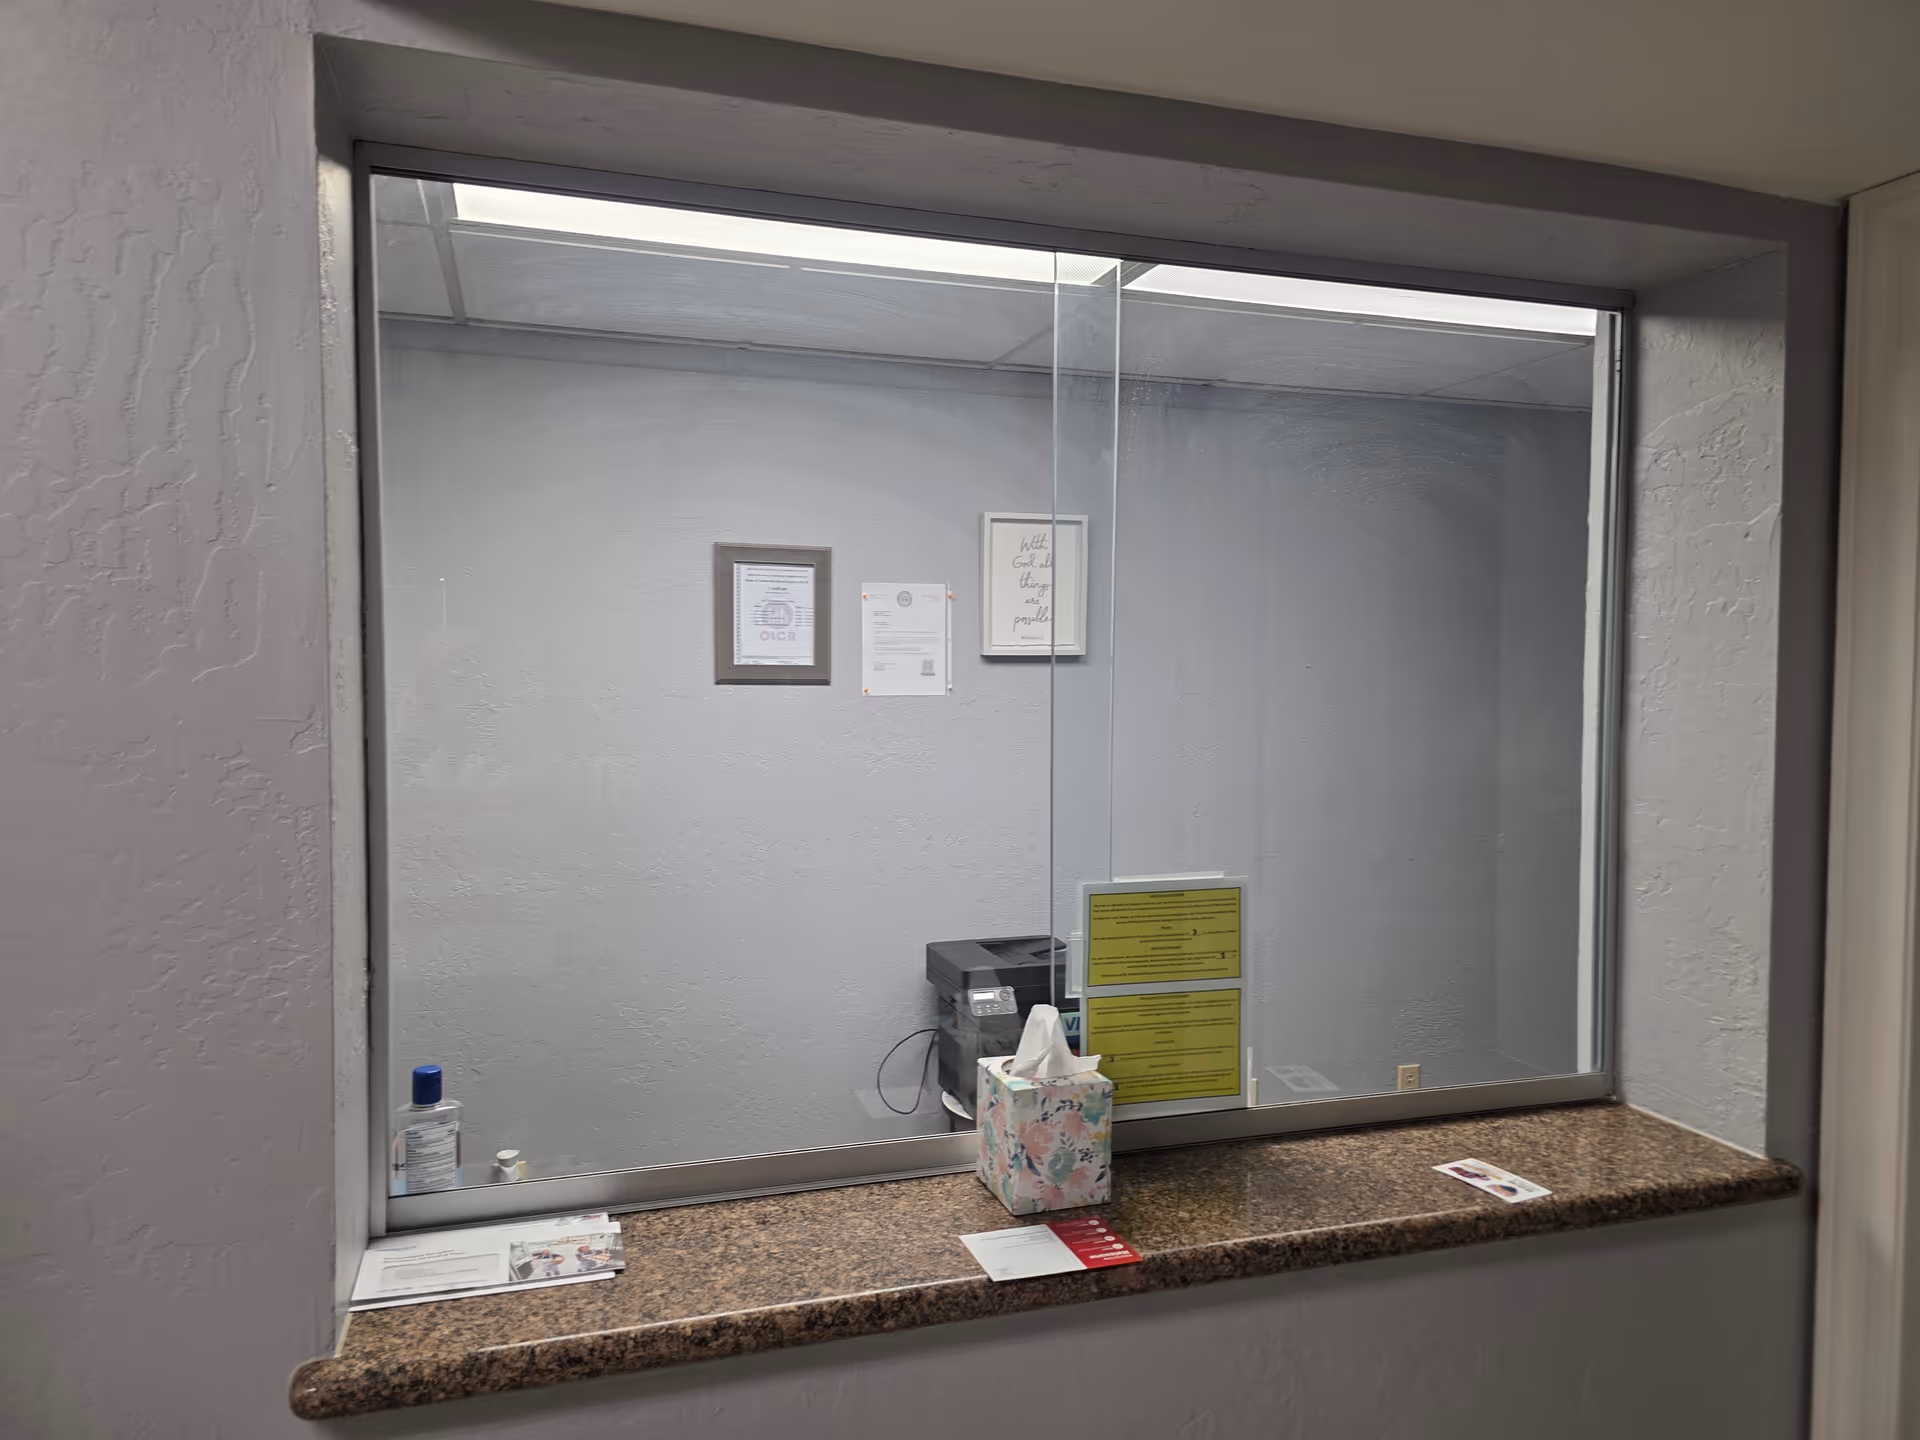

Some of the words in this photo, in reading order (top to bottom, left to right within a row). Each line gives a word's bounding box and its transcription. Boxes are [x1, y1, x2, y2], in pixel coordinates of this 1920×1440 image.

[1020, 532, 1049, 552] With
[1025, 597, 1040, 605] are
[1012, 606, 1052, 632] possible
[1065, 1016, 1080, 1031] VI
